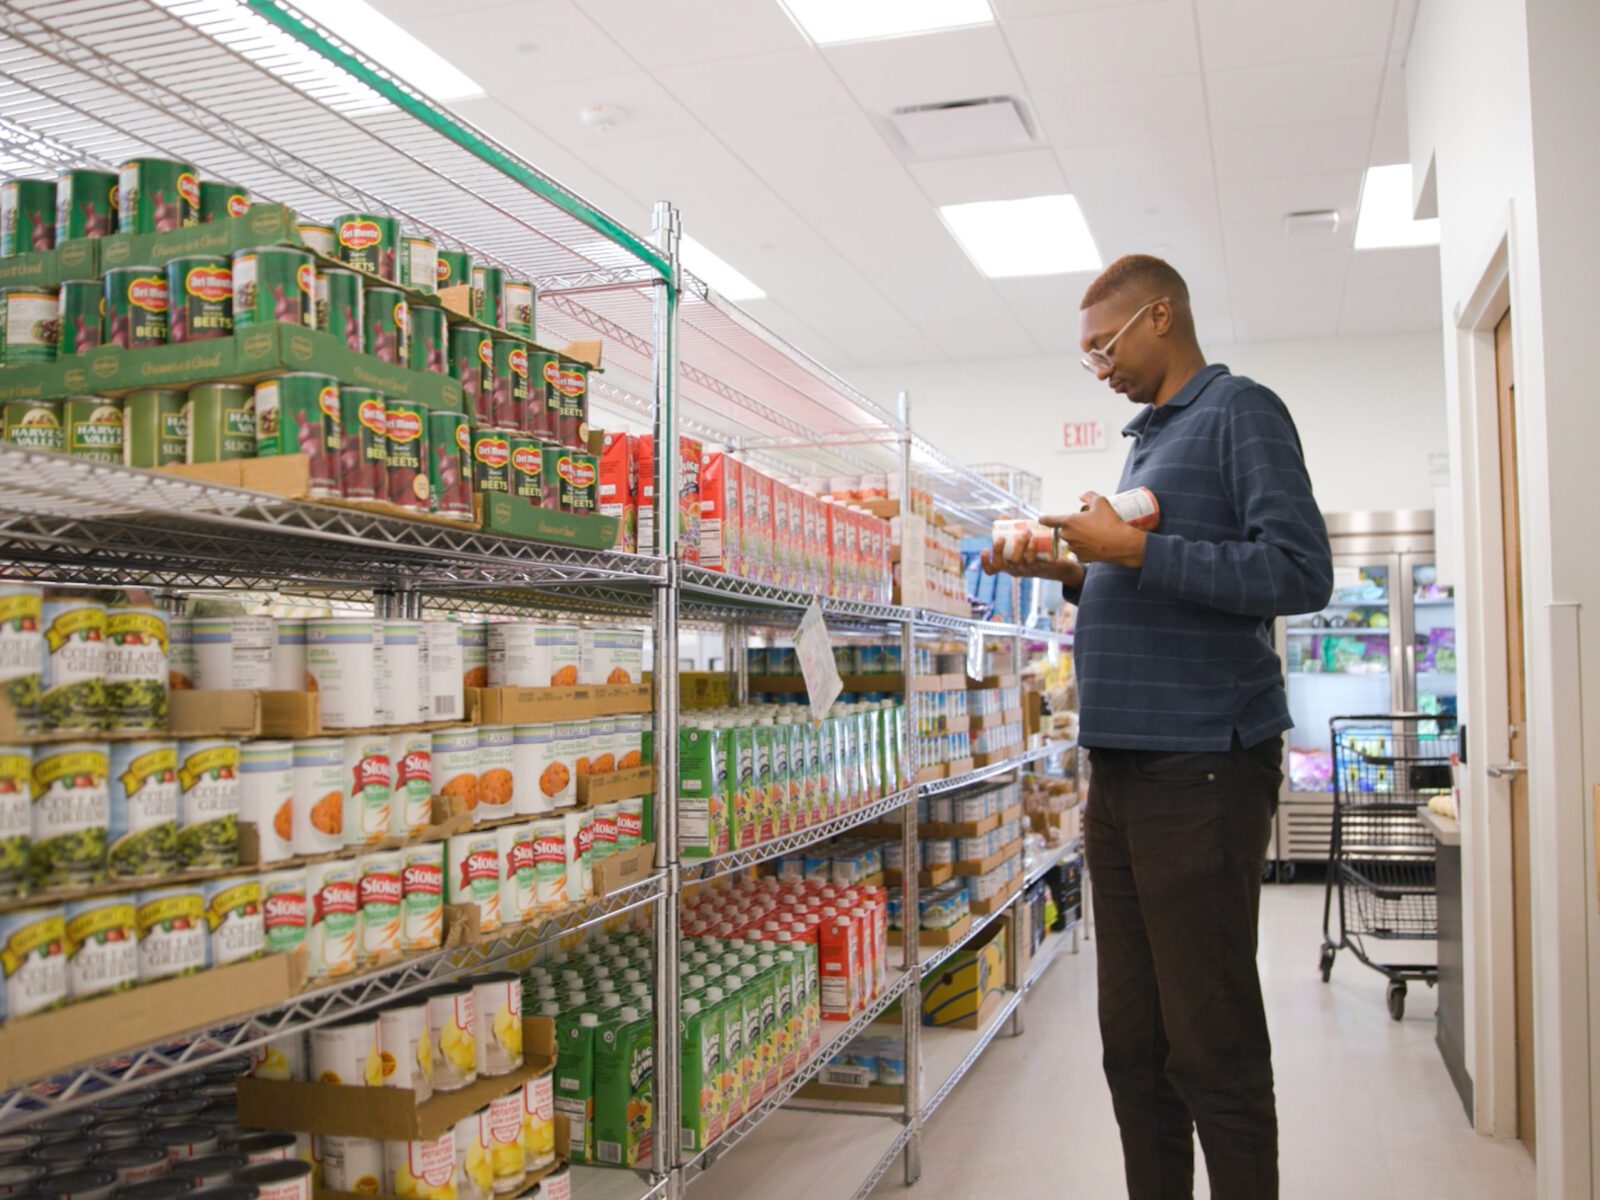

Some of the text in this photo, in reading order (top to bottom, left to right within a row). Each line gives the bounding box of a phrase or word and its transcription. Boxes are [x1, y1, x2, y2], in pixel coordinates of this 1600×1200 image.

[193, 316, 232, 328] BEETS
[135, 325, 167, 338] BEET
[11, 427, 64, 438] HARVES
[1064, 422, 1097, 448] EXIT
[162, 443, 187, 455] SLIC
[481, 480, 508, 492] BEETS
[573, 498, 595, 509] EETS
[60, 646, 105, 660] COLL
[106, 651, 162, 664] OLLARD
[617, 817, 641, 833] toke
